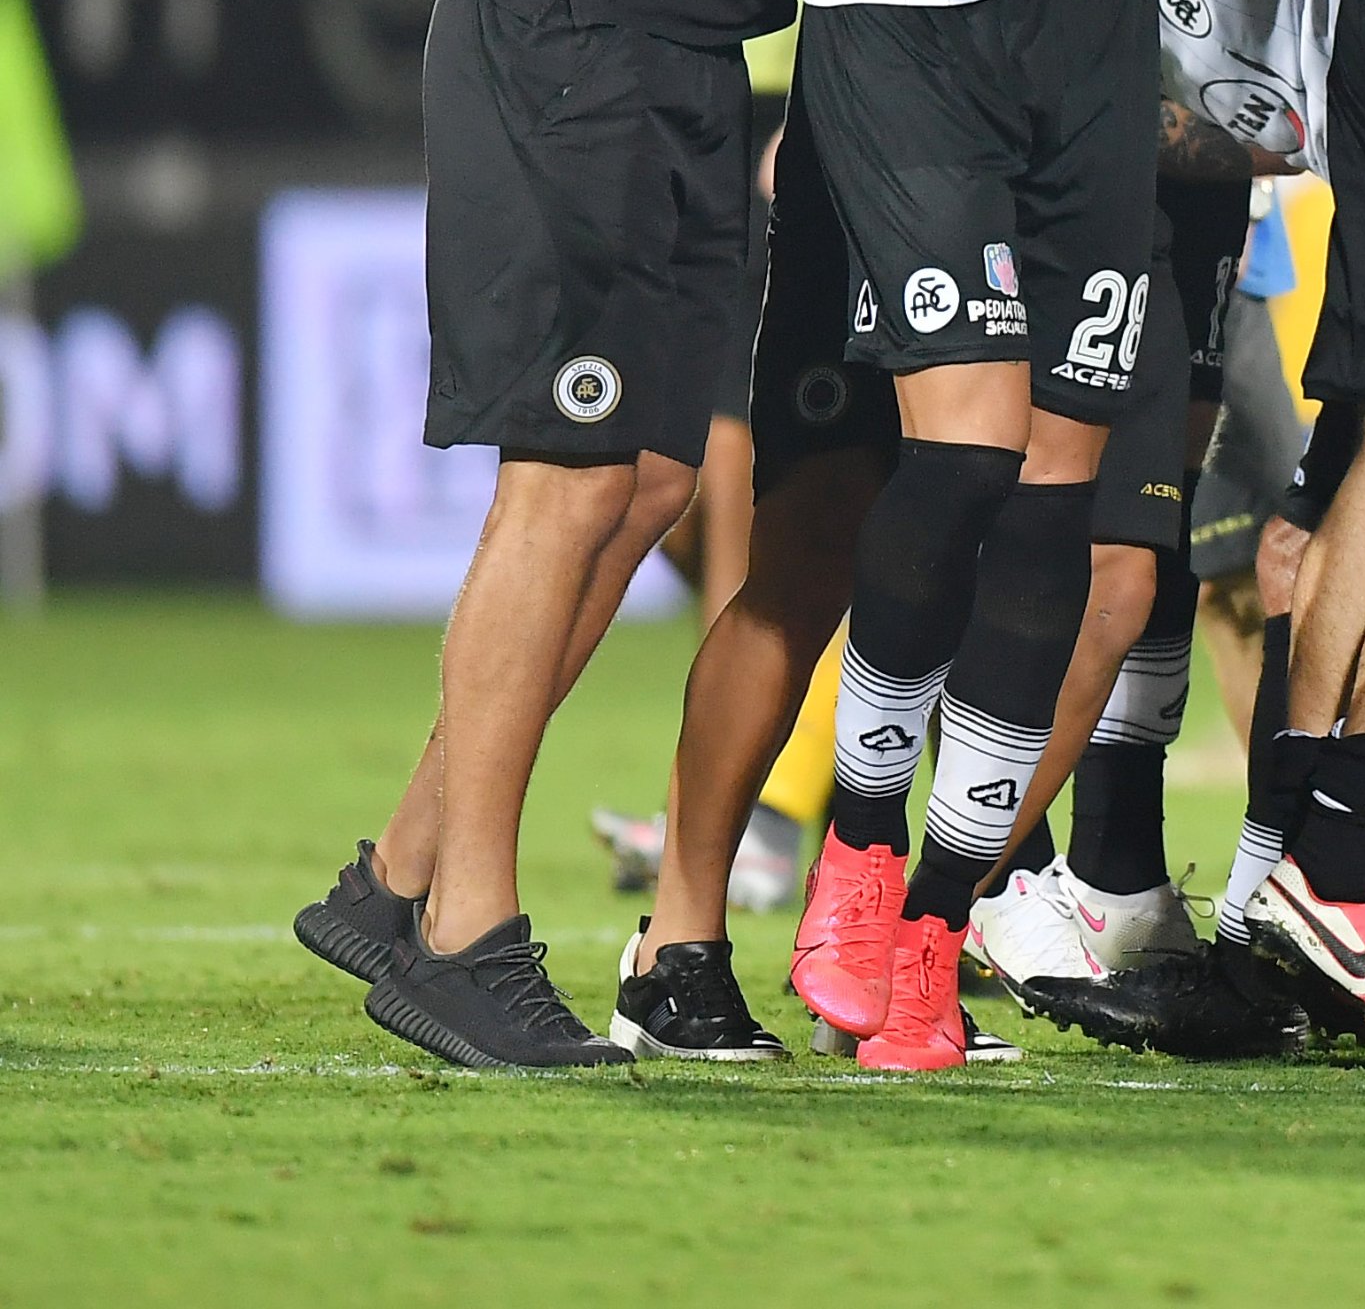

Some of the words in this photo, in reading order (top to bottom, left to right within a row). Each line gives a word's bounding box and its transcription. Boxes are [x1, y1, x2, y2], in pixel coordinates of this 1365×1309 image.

[1066, 269, 1149, 372] 28
[571, 363, 603, 372] SPEZIA
[577, 407, 600, 415] 1906
